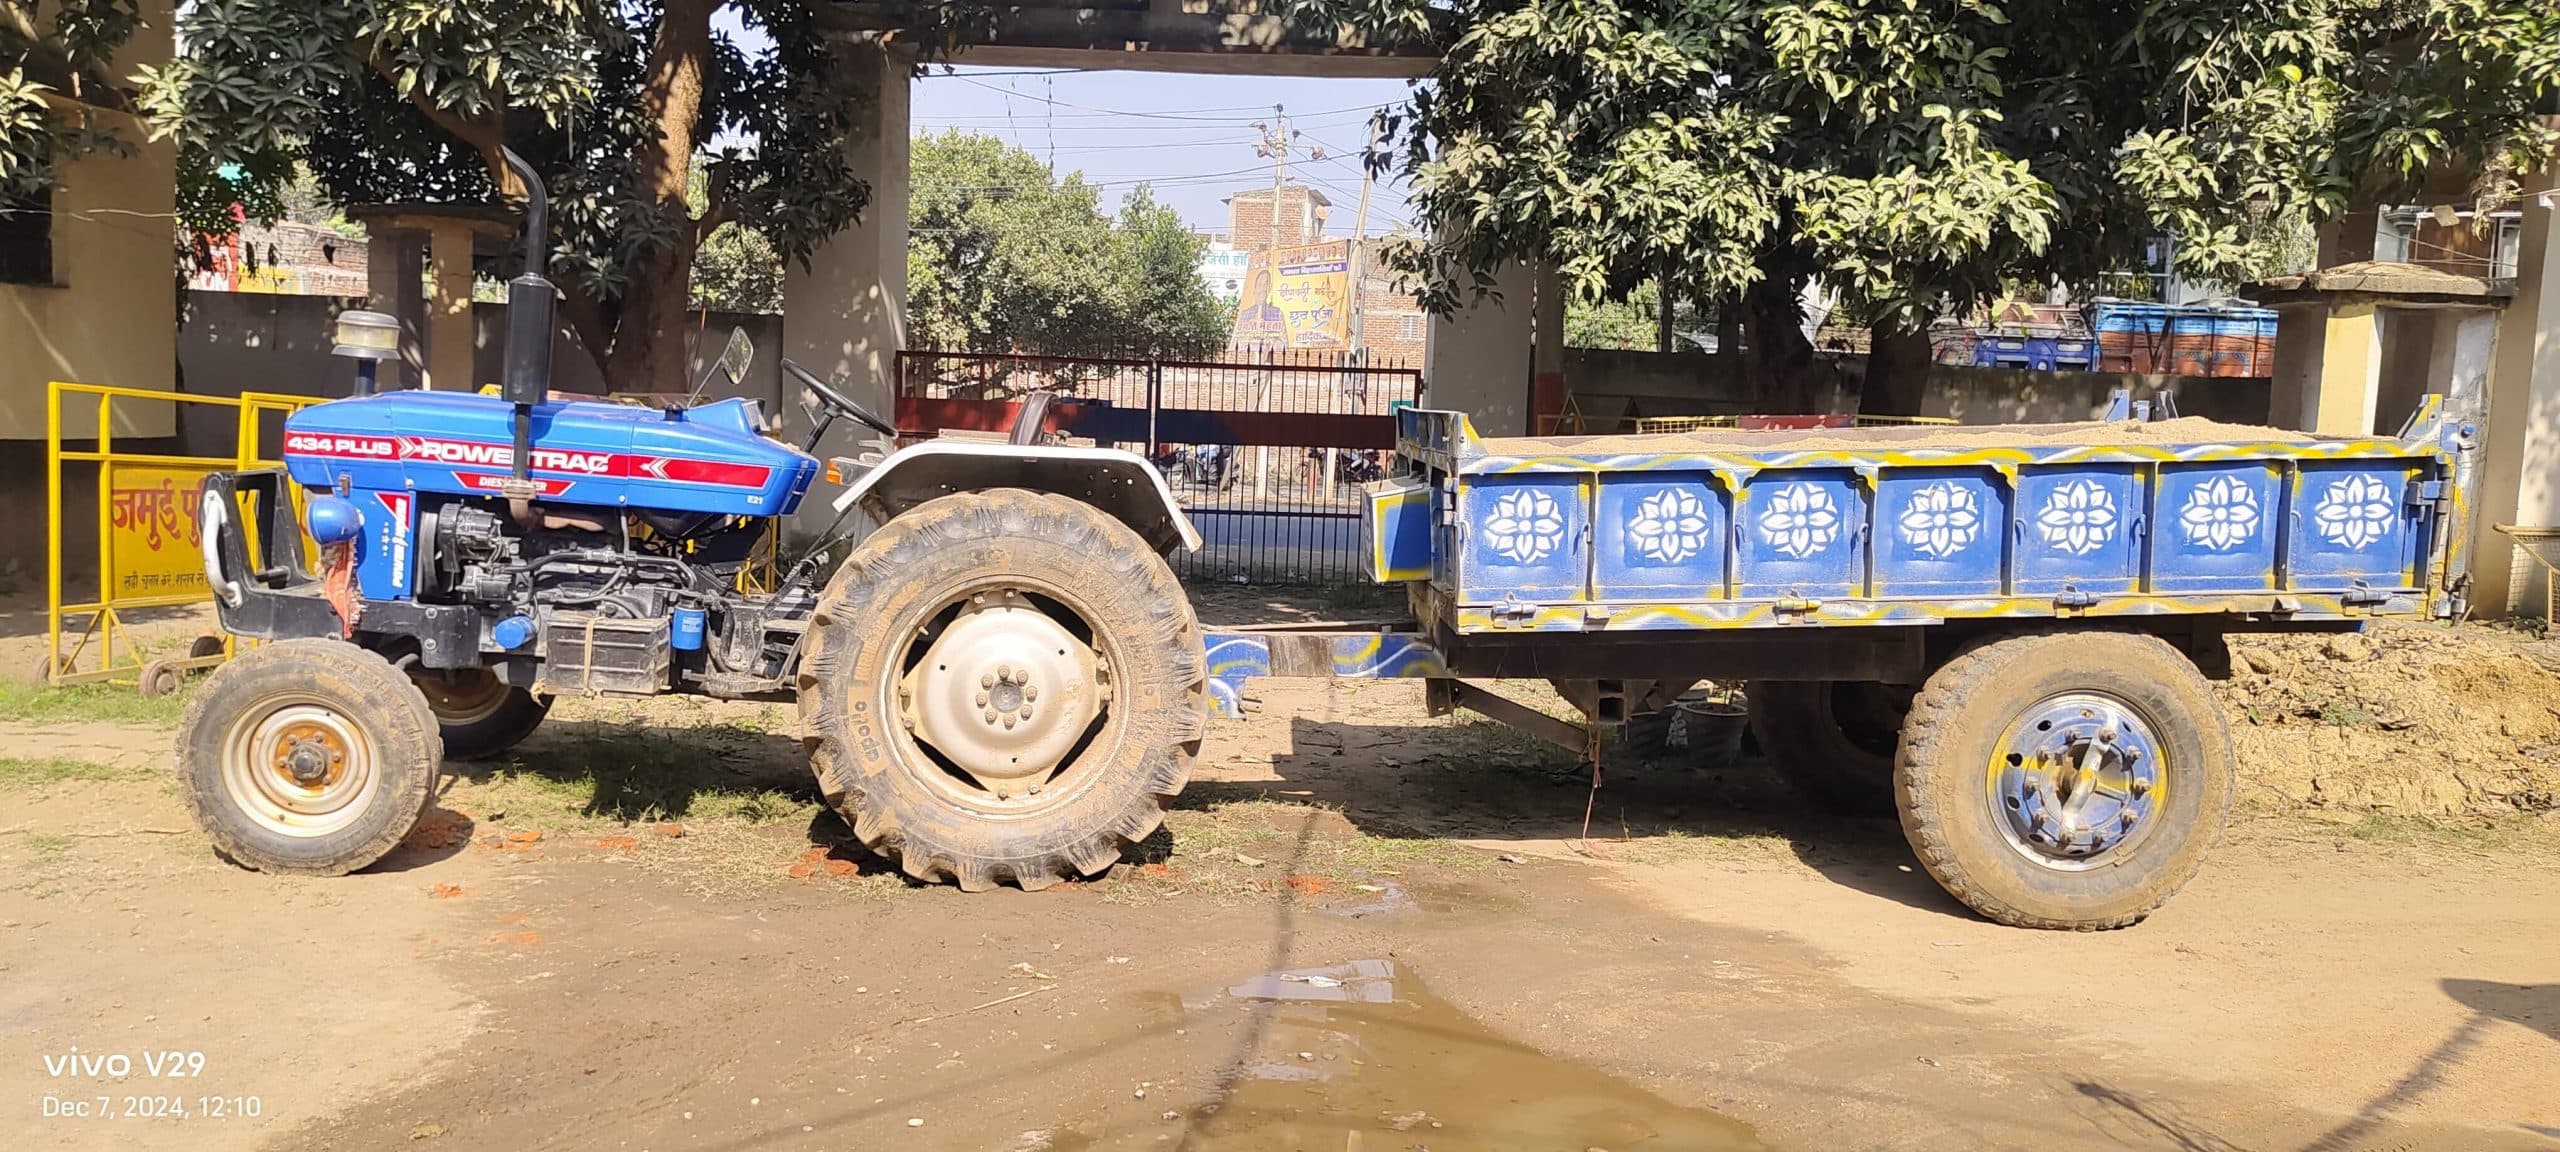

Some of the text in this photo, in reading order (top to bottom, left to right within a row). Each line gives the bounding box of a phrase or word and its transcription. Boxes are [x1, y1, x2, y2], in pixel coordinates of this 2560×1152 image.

[287, 437, 392, 455] 434 PLUS
[421, 441, 610, 473] POWETRAC
[111, 478, 180, 551] जमुई
